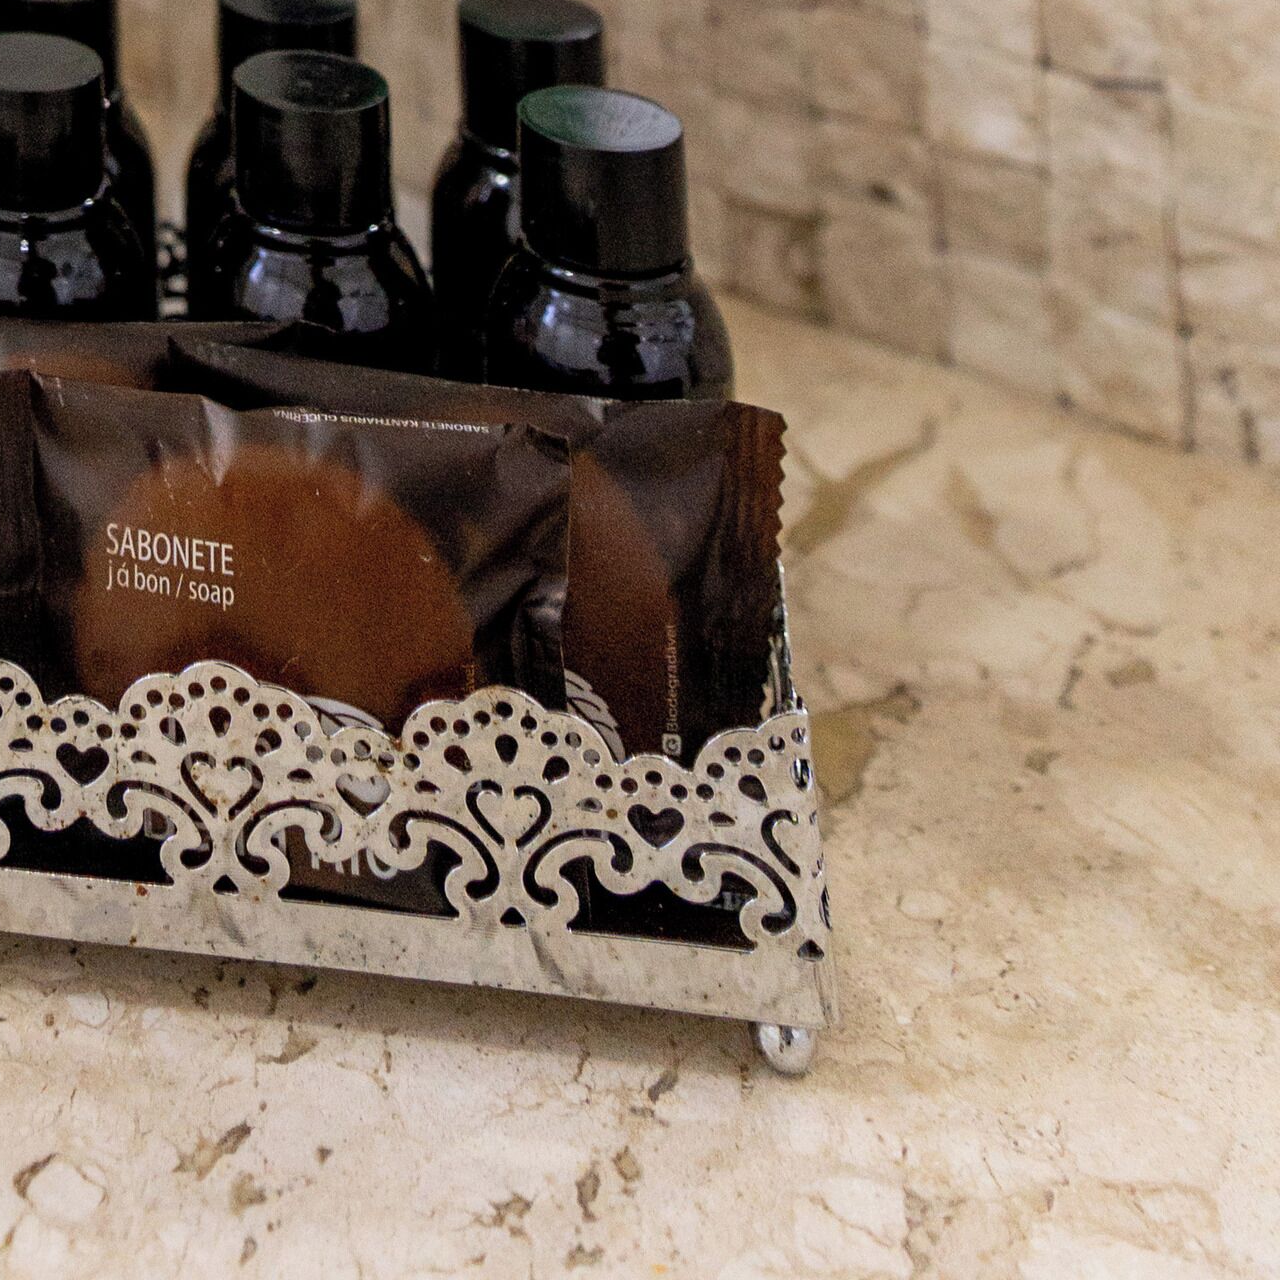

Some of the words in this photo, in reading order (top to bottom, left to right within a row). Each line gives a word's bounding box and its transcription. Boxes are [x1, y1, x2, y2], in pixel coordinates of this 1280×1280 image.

[421, 420, 490, 434] SABONETE
[106, 523, 234, 576] SABONETE
[189, 581, 235, 611] soap
